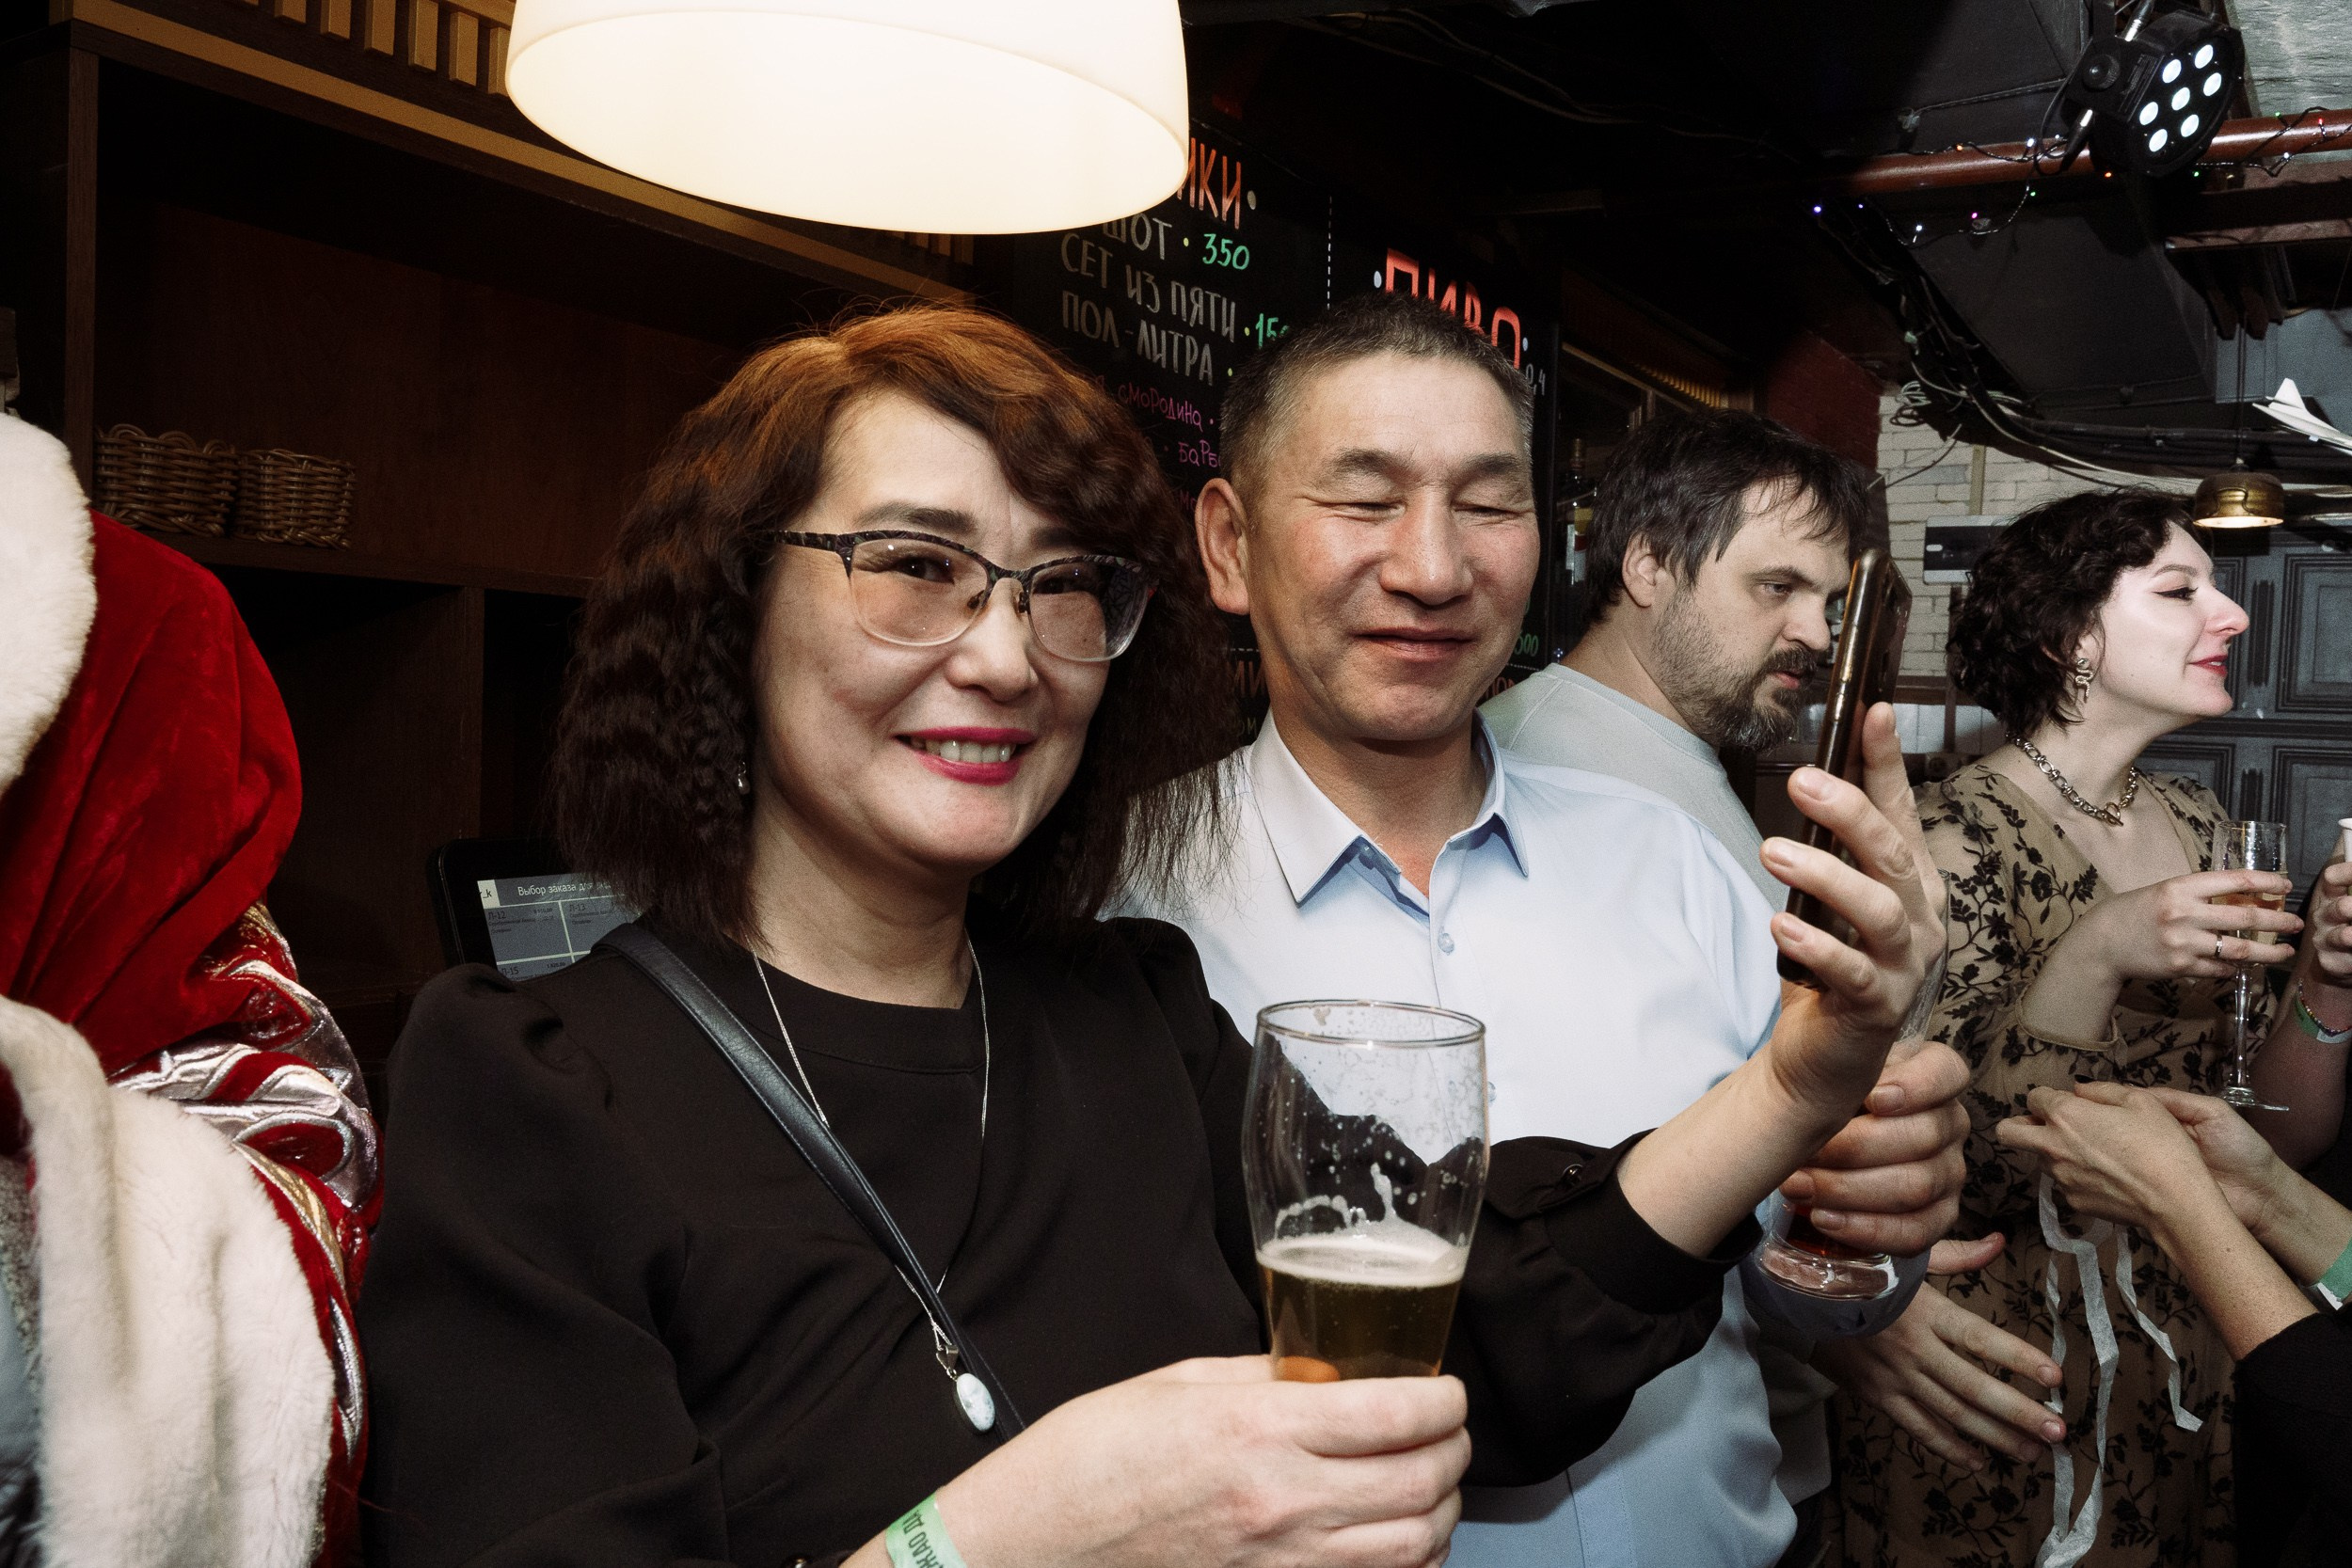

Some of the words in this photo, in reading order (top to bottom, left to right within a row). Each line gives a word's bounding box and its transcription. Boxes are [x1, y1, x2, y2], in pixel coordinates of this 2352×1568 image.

[1201, 233, 1250, 271] 350
[1060, 232, 1113, 289] СЕТ
[1125, 264, 1160, 313] ИЗ
[1170, 280, 1236, 343] ПЯТИ
[517, 885, 546, 896] Выбор
[548, 883, 577, 894] заказа
